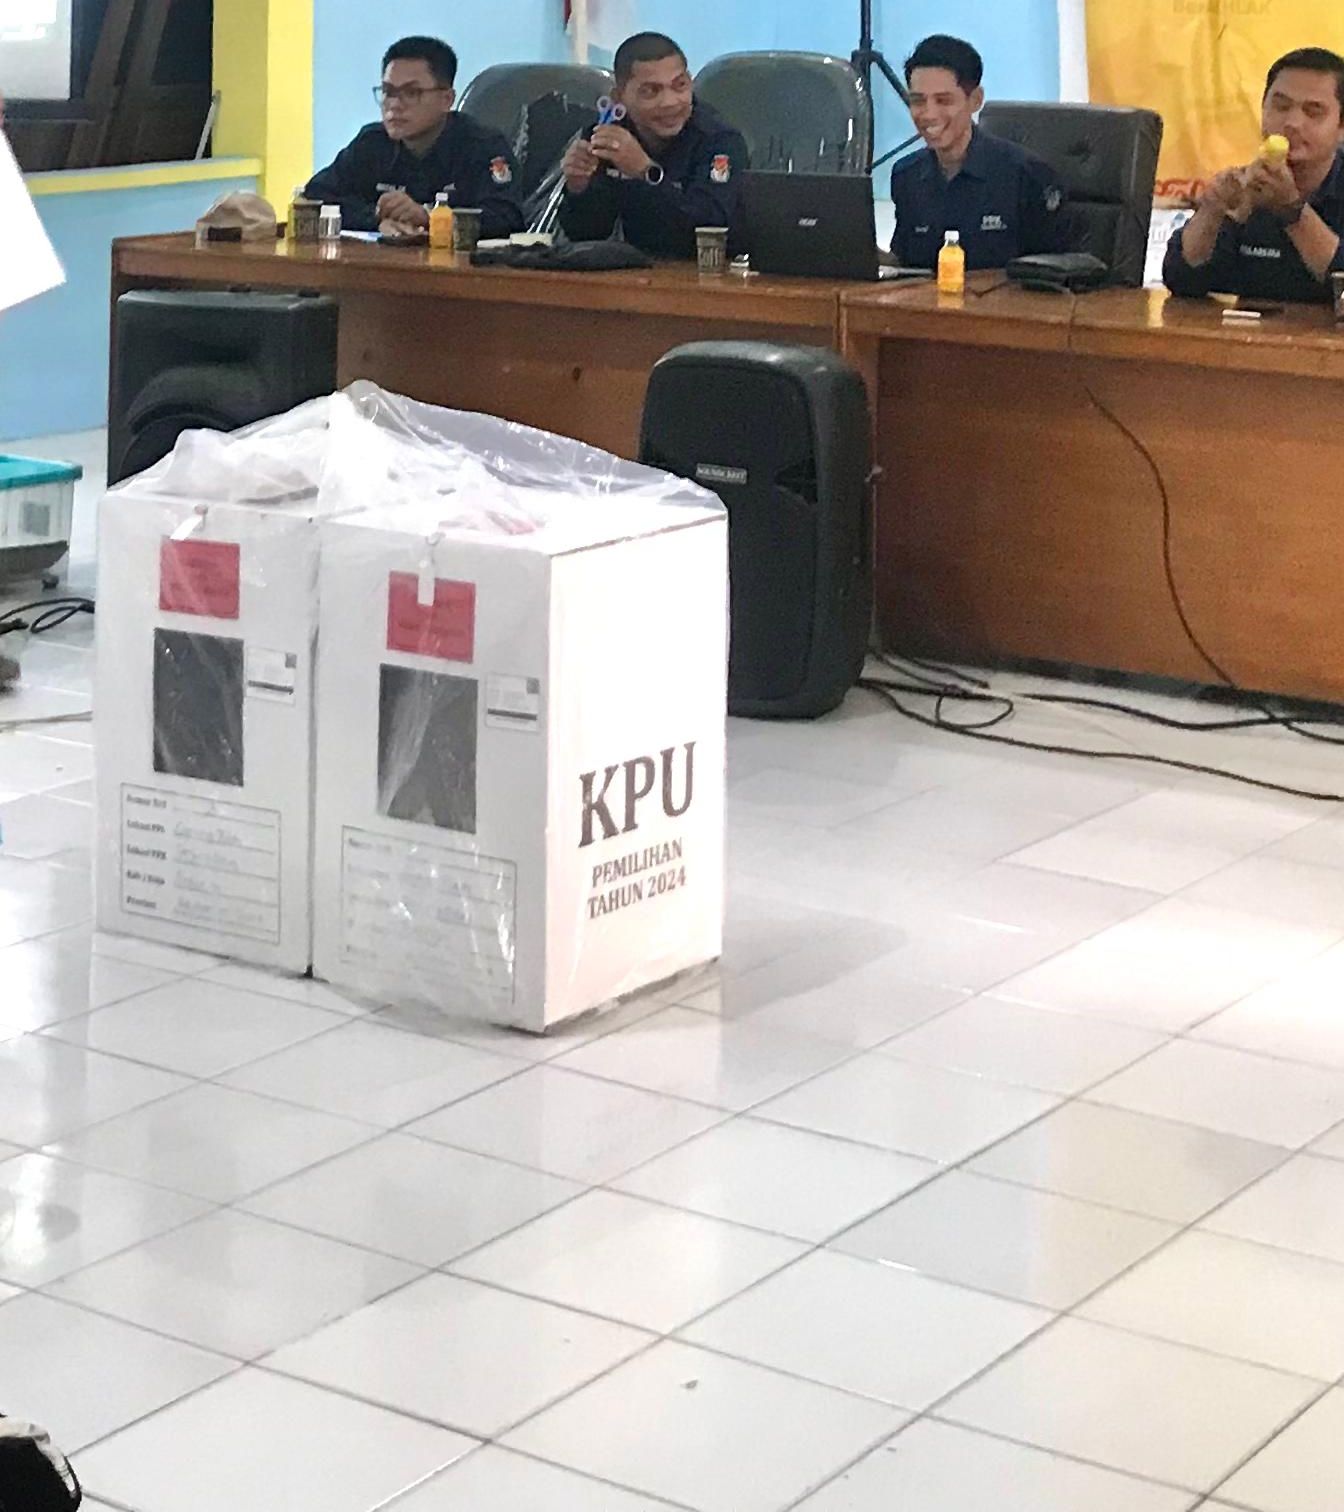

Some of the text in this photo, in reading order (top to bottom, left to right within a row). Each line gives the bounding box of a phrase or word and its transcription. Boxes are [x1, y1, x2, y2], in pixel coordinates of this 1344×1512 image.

[578, 741, 697, 848] KPU
[592, 837, 683, 888] PEMILIHAN
[587, 865, 688, 920] TAHUN 2024
